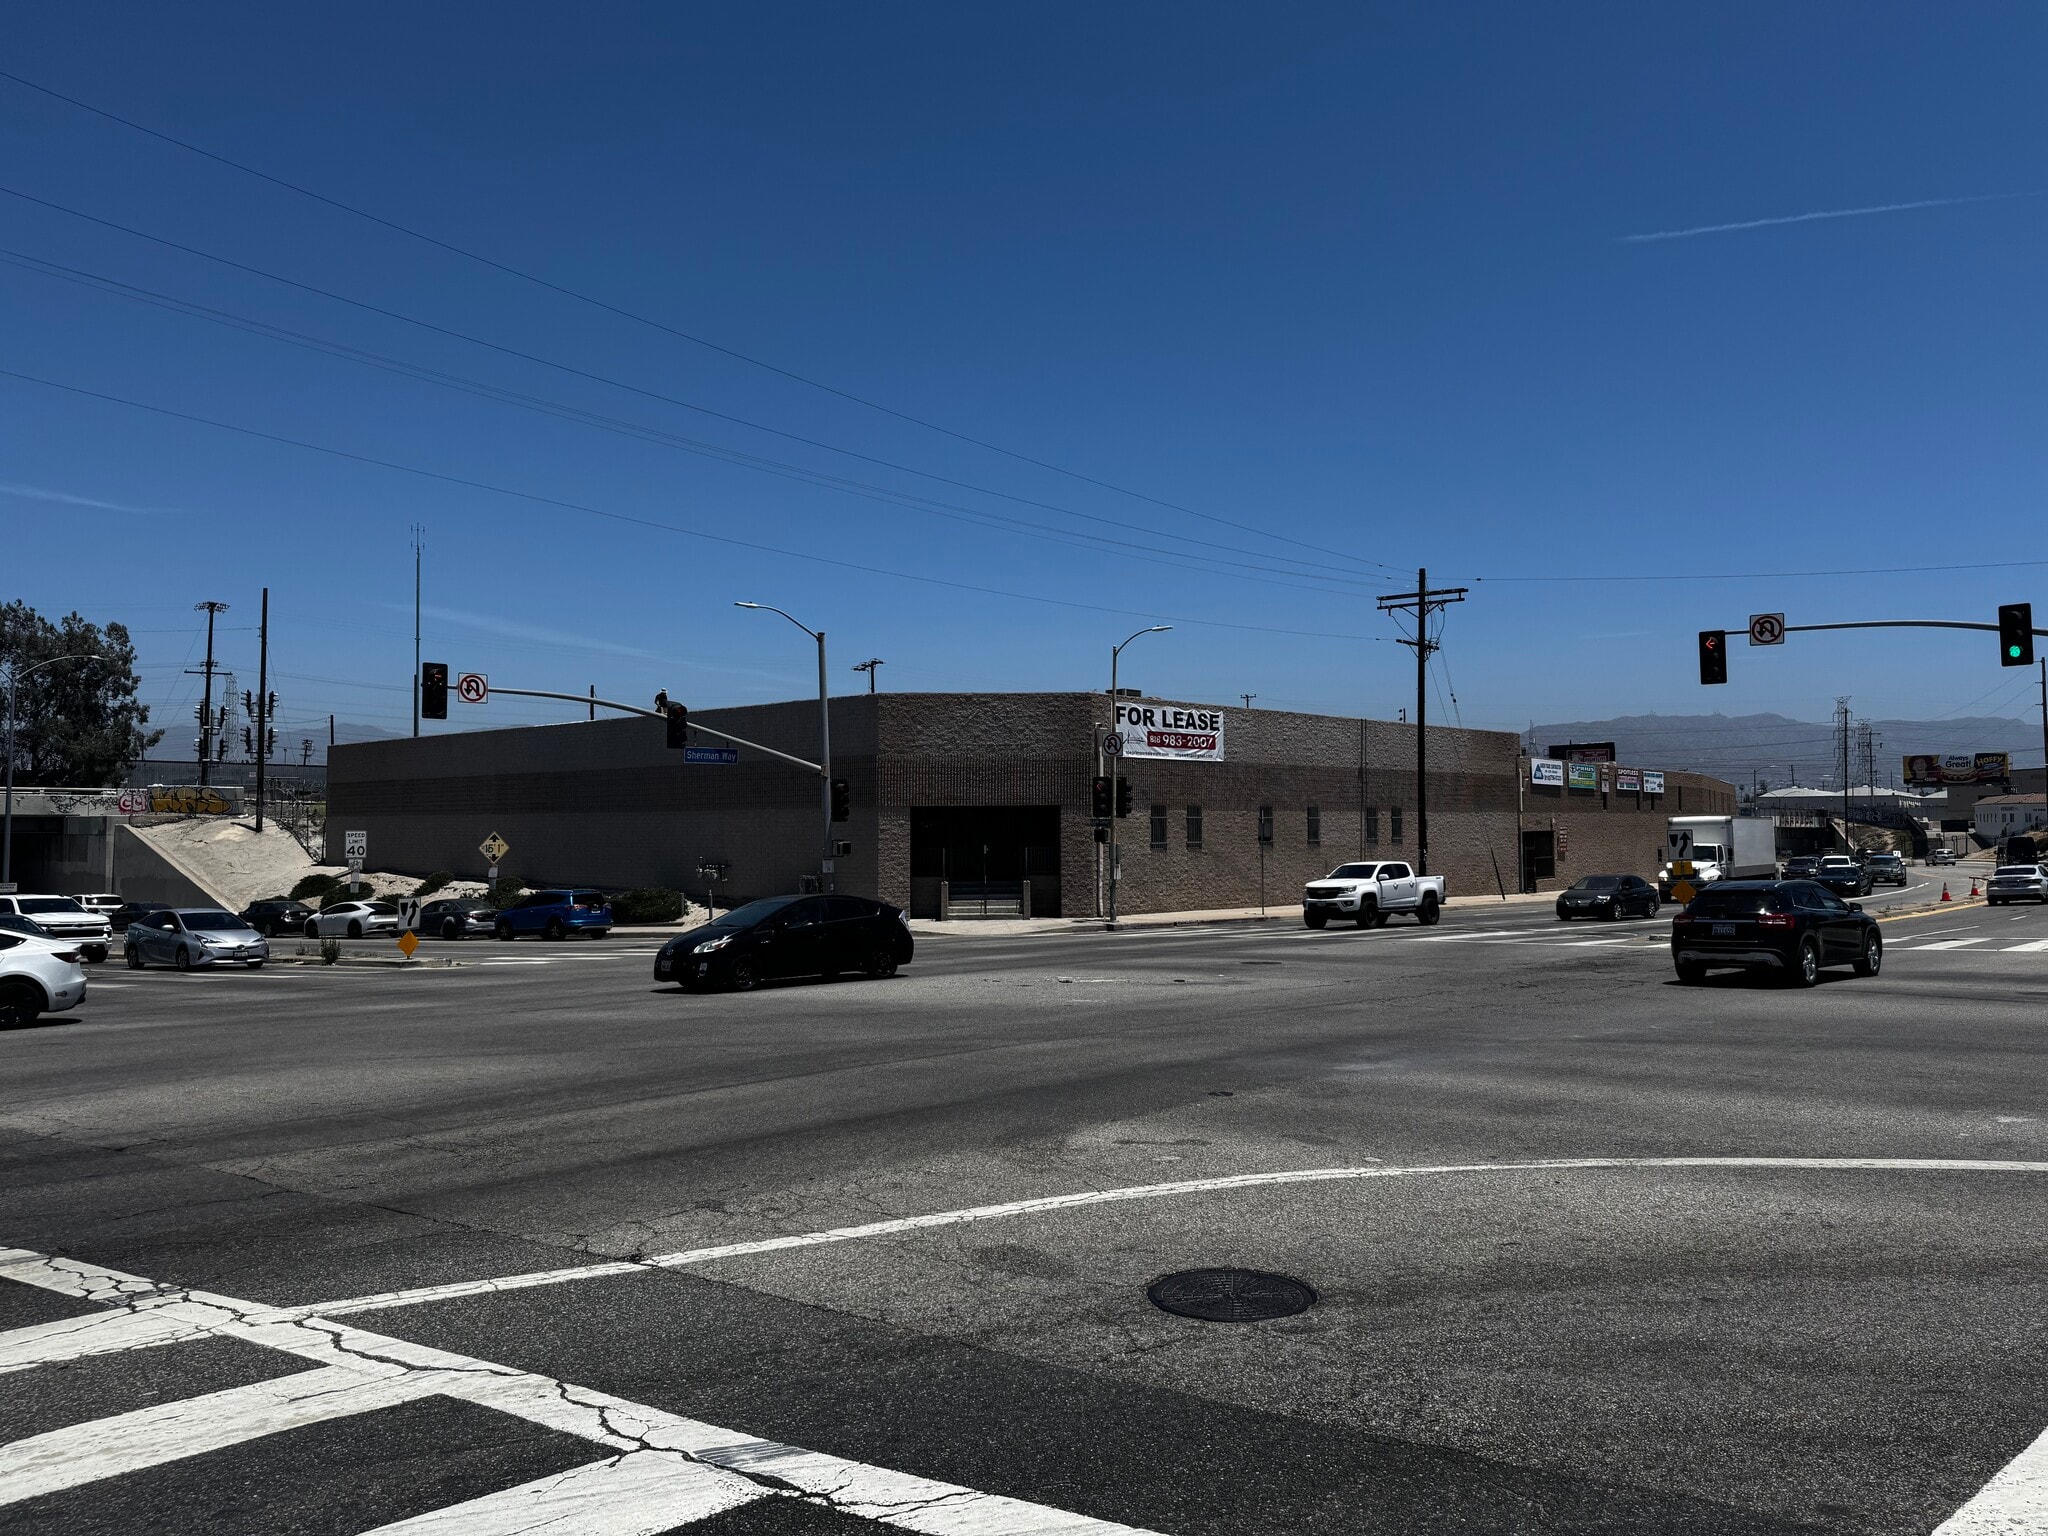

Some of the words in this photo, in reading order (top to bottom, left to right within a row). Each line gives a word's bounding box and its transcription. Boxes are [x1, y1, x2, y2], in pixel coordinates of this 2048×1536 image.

[1116, 706, 1155, 727] FOR
[1162, 710, 1220, 731] LEASE
[1162, 734, 1213, 748] 983-2007
[686, 750, 720, 760] Sherman
[722, 752, 737, 762] Way
[346, 845, 365, 856] 40
